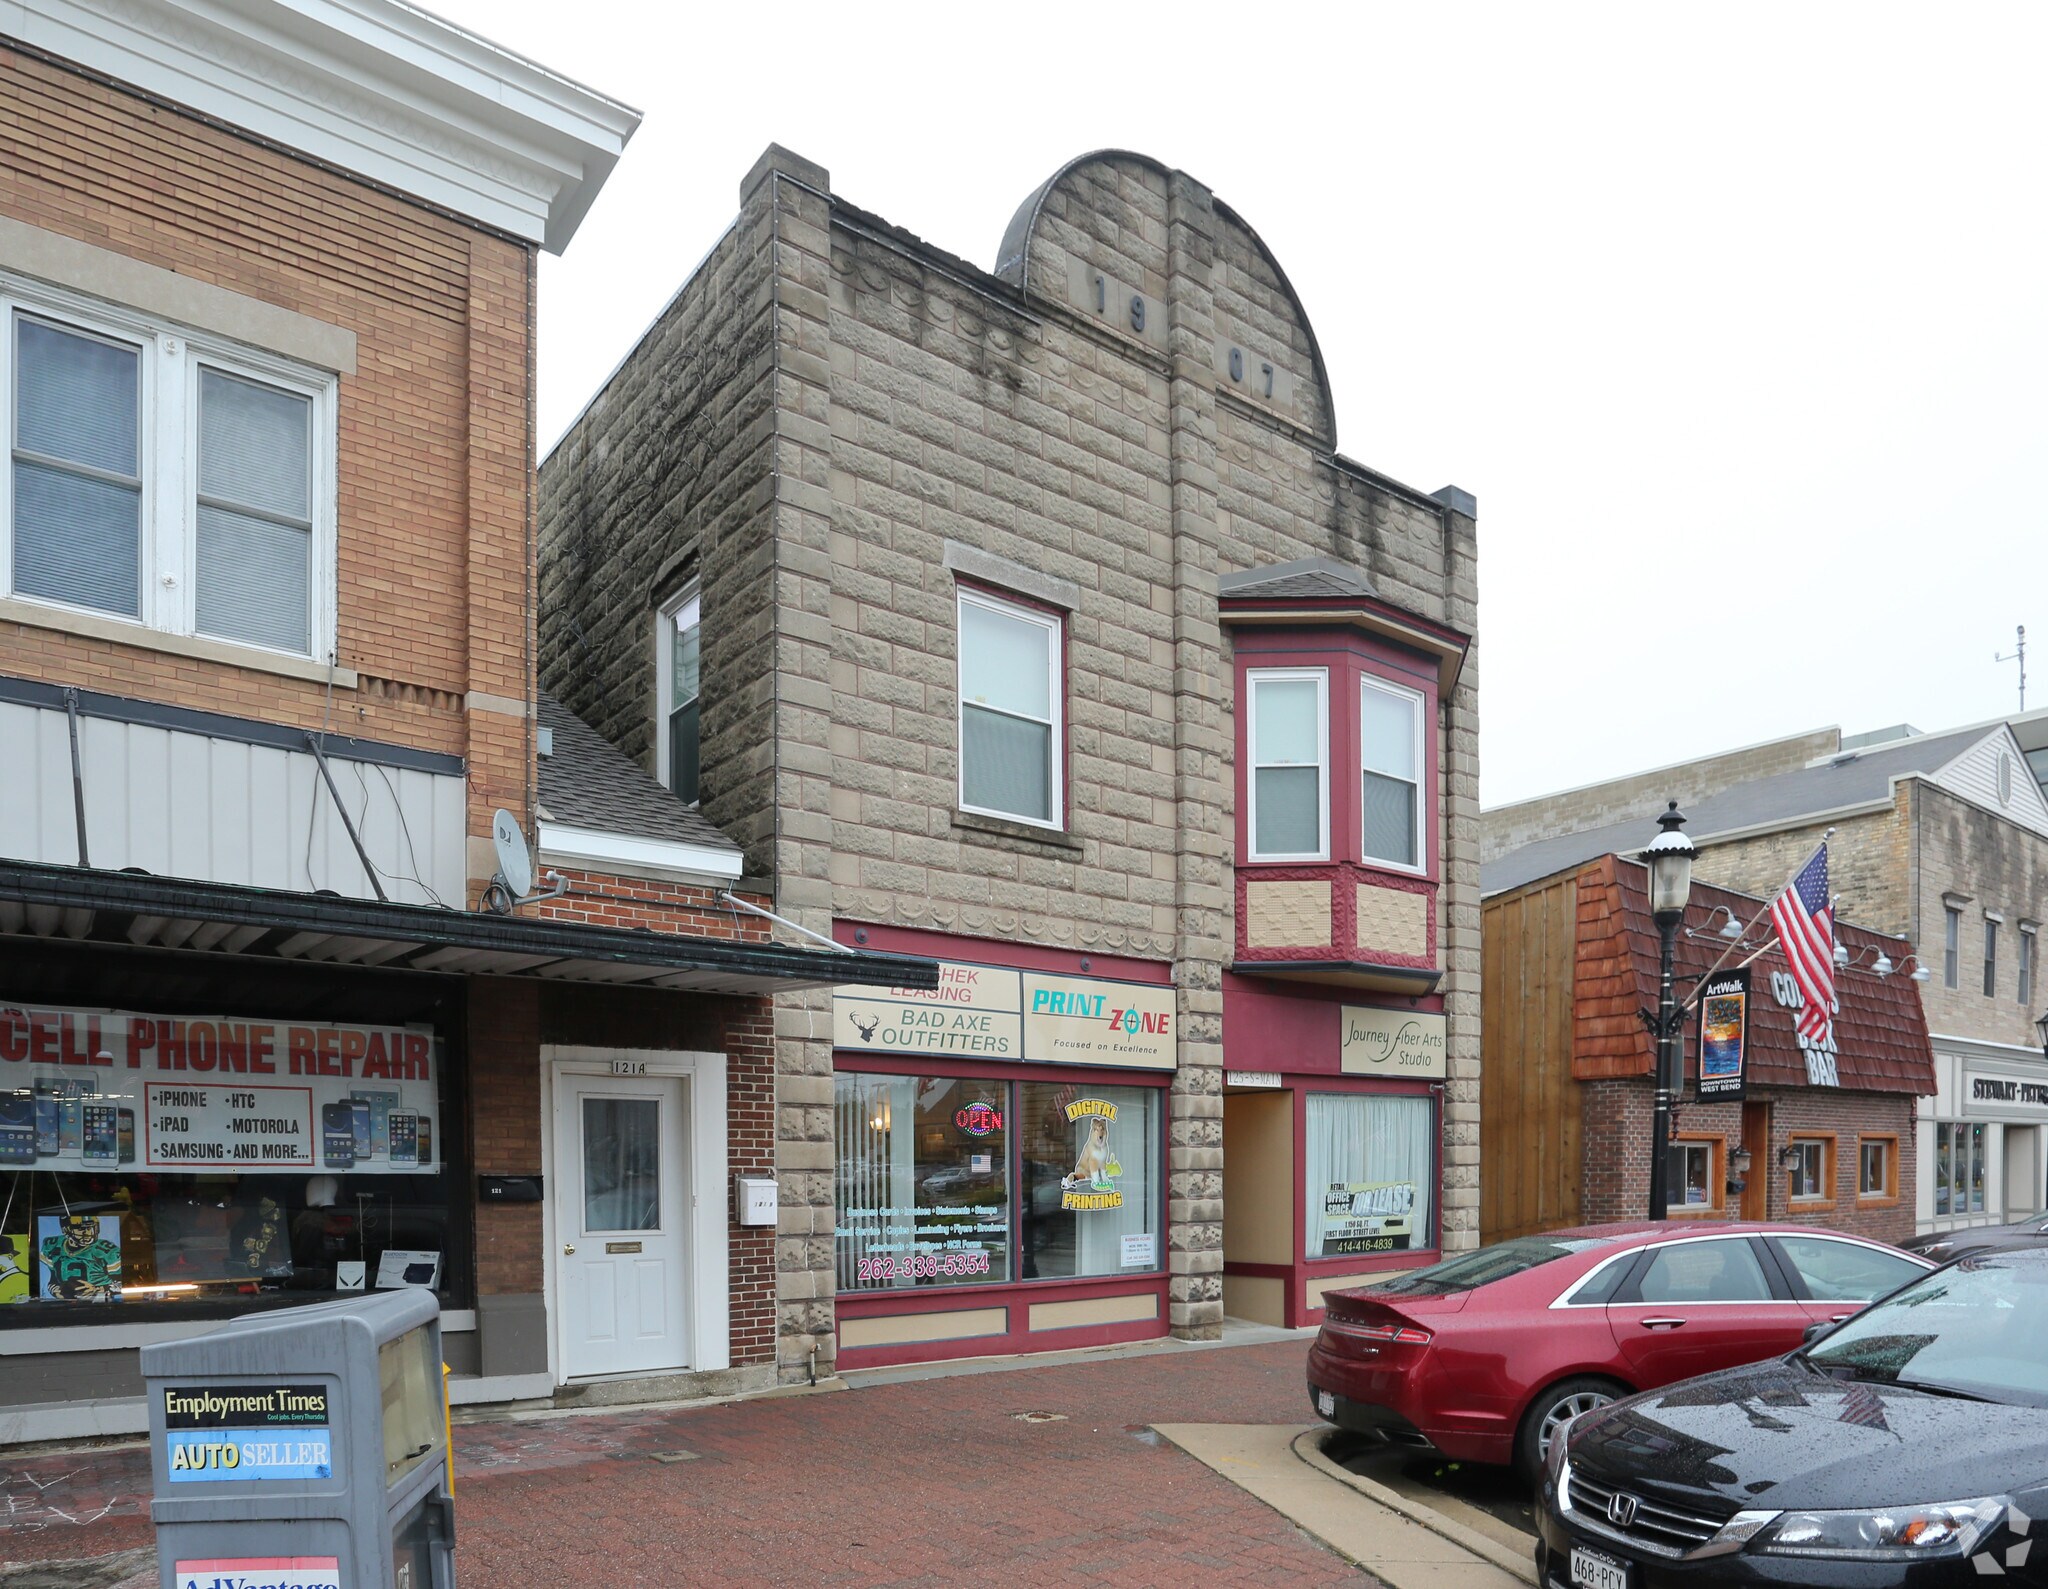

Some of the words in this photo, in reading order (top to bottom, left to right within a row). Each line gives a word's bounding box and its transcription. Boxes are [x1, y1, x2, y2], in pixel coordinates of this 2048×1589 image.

[1706, 980, 1743, 996] ArtWalk
[901, 1009, 945, 1028] BAD
[952, 1014, 992, 1032] AXE
[1032, 989, 1106, 1017] PRINT
[1108, 1008, 1170, 1034] ZONE
[0, 1009, 113, 1067] CELL
[127, 1018, 276, 1074] PHONE
[288, 1027, 430, 1080] REPAIR
[882, 1028, 1009, 1053] OUTFITTERS
[1053, 1039, 1091, 1049] Focused
[1097, 1042, 1107, 1050] on
[1113, 1043, 1158, 1054] Excellence
[1344, 1020, 1389, 1054] Journey
[1422, 1033, 1442, 1047] Arts
[615, 1061, 645, 1074] 121A
[1399, 1050, 1431, 1066] Studio
[1804, 1049, 1840, 1087] BAR
[1701, 1077, 1741, 1087] DOWNTOWN
[1701, 1085, 1719, 1093] WEST
[1720, 1083, 1741, 1091] BEND
[159, 1091, 207, 1107] iPHONE
[231, 1093, 255, 1109] HTC
[956, 1110, 1002, 1130] OPEN
[1065, 1099, 1118, 1122] DIGITAL
[160, 1117, 189, 1132] iPAD
[233, 1118, 299, 1134] MOTOROLA
[160, 1143, 224, 1159] SAMSUNG
[233, 1144, 258, 1159] AND
[1062, 1191, 1123, 1211] PRINTING
[1326, 1191, 1350, 1204] OFFICE
[1372, 1183, 1411, 1217] LEASE
[1326, 1203, 1349, 1216] SPACE
[1337, 1238, 1393, 1253] 414-416-4839
[858, 1253, 990, 1281] 262-338-5354
[166, 1392, 275, 1419] Employment
[276, 1389, 325, 1411] Times
[267, 1413, 279, 1421] Cool
[291, 1413, 304, 1421] Every
[304, 1413, 326, 1421] Thursday
[172, 1443, 240, 1470] AUTO
[242, 1442, 329, 1467] SELLER
